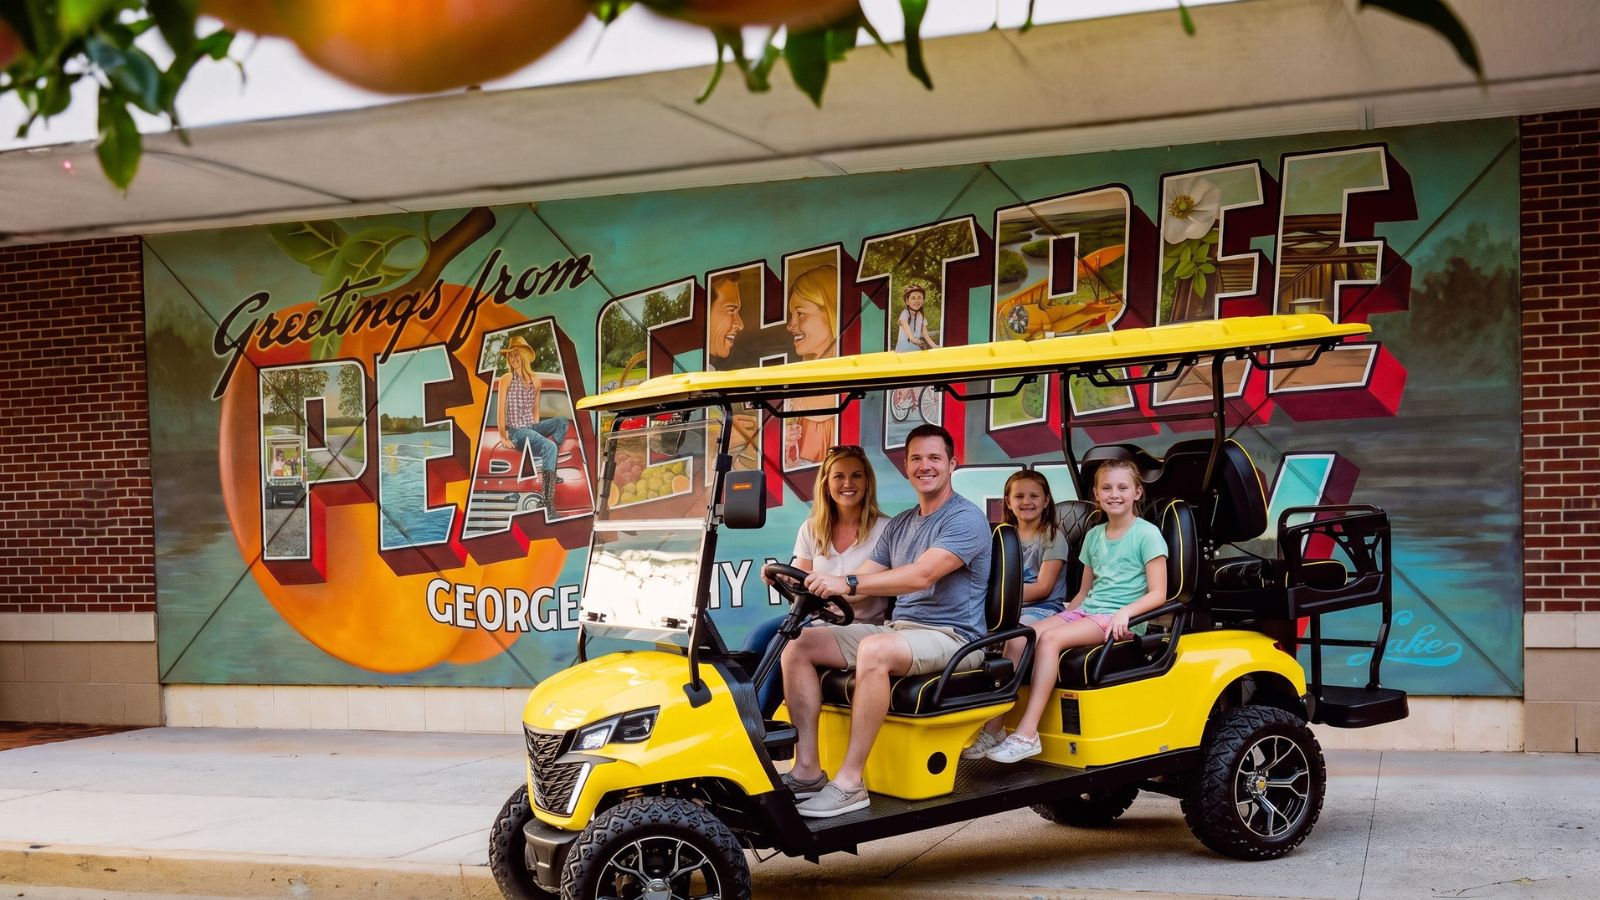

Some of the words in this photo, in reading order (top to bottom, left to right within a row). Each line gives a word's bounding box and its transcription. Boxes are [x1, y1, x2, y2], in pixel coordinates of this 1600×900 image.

[212, 276, 446, 399] Greetings
[447, 248, 594, 354] from
[257, 142, 1408, 582] PEACHTREE
